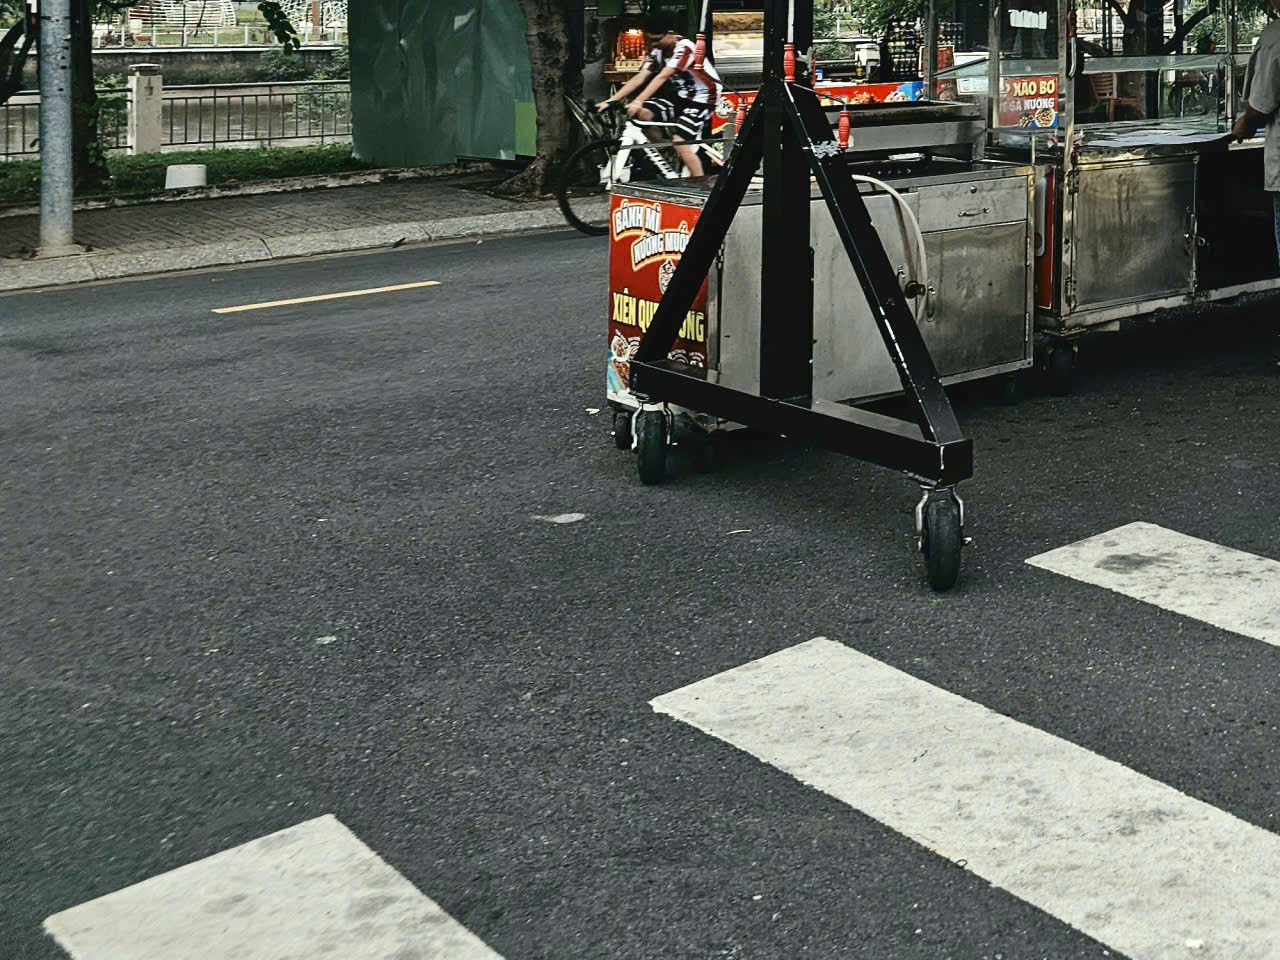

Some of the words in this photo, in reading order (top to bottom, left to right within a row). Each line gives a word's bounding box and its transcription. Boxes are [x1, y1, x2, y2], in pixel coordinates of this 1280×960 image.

[615, 202, 643, 234] BÁNH
[645, 205, 660, 233] MÌ
[665, 223, 690, 253] MUỐ
[613, 288, 636, 326] XIÊN
